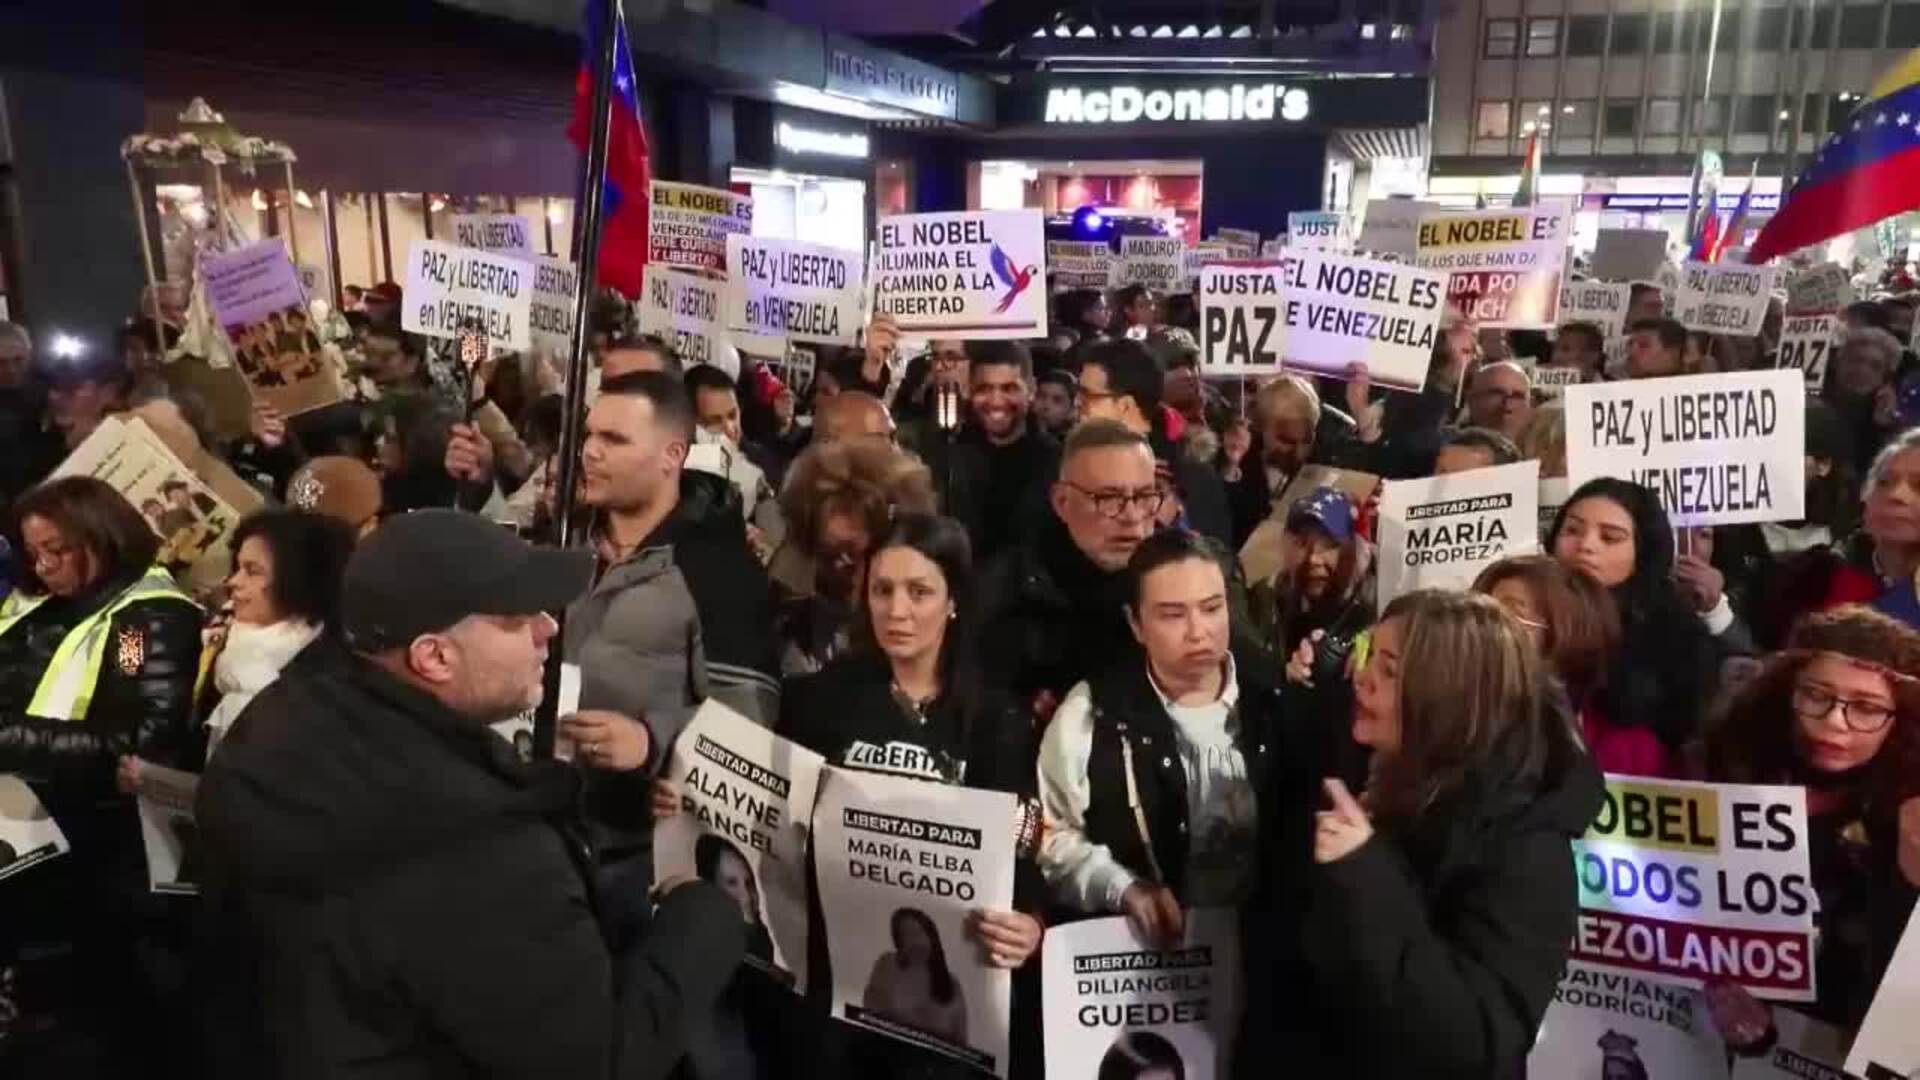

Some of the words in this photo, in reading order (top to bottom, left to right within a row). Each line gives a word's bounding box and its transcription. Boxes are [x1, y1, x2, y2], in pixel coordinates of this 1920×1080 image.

[1045, 84, 1309, 122] McDonald's
[654, 189, 672, 206] EL
[680, 191, 732, 215] NOBEL
[736, 202, 753, 220] ES
[458, 223, 476, 248] PAZ
[485, 221, 524, 249] LIBERTAD
[882, 225, 906, 248] EL
[913, 220, 992, 246] NOBEL
[1297, 220, 1350, 240] JUST
[1419, 224, 1441, 246] EL
[1447, 218, 1523, 244] NOBEL
[1532, 216, 1560, 240] ES
[663, 249, 718, 266] LIBERTAD
[882, 251, 950, 271] ILUMINA
[955, 251, 977, 268] EL
[1123, 239, 1182, 259] ¿MADURO?
[1457, 252, 1483, 267] QUE
[1486, 250, 1515, 265] HAN
[422, 249, 447, 283] PAZ
[448, 261, 458, 294] y
[458, 258, 519, 299] LIBERTAD
[742, 248, 767, 279] PAZ
[769, 256, 778, 291] y
[781, 251, 846, 290] LIBERTAD
[881, 274, 948, 293] CAMINO
[954, 273, 966, 291] A
[972, 272, 996, 290] LA
[1206, 274, 1277, 295] JUSTA
[1285, 257, 1307, 288] EL
[1316, 261, 1400, 302] NOBEL
[1409, 277, 1440, 309] ES
[1449, 274, 1481, 294] IDA
[1487, 273, 1517, 294] PO
[420, 301, 435, 328] en
[439, 299, 512, 343] VENEZUELA
[746, 300, 760, 325] en
[763, 295, 840, 337] VENEZUELA
[882, 295, 965, 315] LIBERTAD
[1464, 298, 1508, 319] UCH
[1205, 306, 1277, 364] PAZ
[1286, 301, 1300, 325] E
[1308, 302, 1433, 350] VENEZUELA
[1785, 318, 1829, 334] JUSTA
[1779, 341, 1826, 381] PAZ
[1535, 370, 1577, 386] JUSTA
[1592, 400, 1635, 447] PAZ
[1641, 408, 1653, 457] y
[1660, 388, 1777, 444] LIBERTAD
[1406, 502, 1468, 519] LIBERTAD
[1471, 496, 1509, 511] PARA
[1406, 516, 1508, 549] MARÍA
[696, 736, 750, 777] LIBERTAD
[750, 768, 787, 796] PARA
[685, 767, 781, 830] ALAYNE
[681, 796, 781, 862] RANGEL
[844, 811, 924, 838] LIBERTAD
[928, 828, 976, 847] PARA
[1592, 791, 1716, 847] OBEL
[1732, 802, 1796, 852] ES
[848, 838, 912, 864] MARÍA
[919, 851, 974, 875] ELBA
[849, 860, 975, 901] DELGADO
[1580, 853, 1703, 908] ODOS
[1717, 870, 1808, 916] LOS
[1075, 954, 1158, 971] LIBERTAD
[1078, 998, 1209, 1028] GUEDEZ
